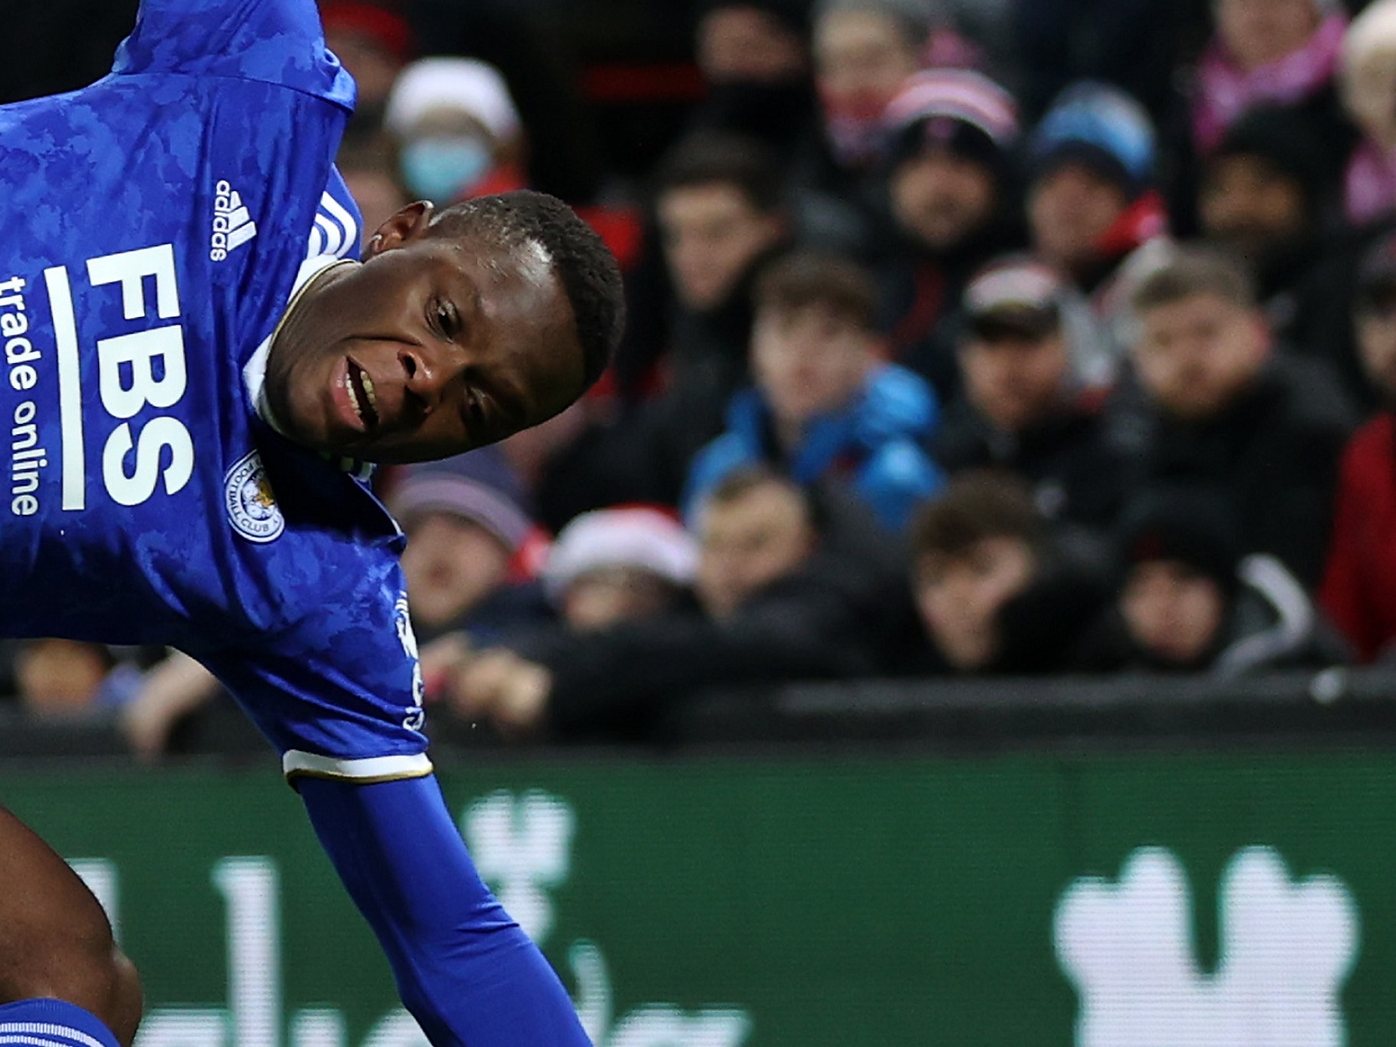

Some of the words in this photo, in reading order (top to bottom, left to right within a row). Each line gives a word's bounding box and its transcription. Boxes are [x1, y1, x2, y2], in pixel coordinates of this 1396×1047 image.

[210, 179, 231, 262] adidas
[86, 243, 195, 506] FBS
[11, 401, 48, 516] online
[240, 518, 270, 533] CLUB
